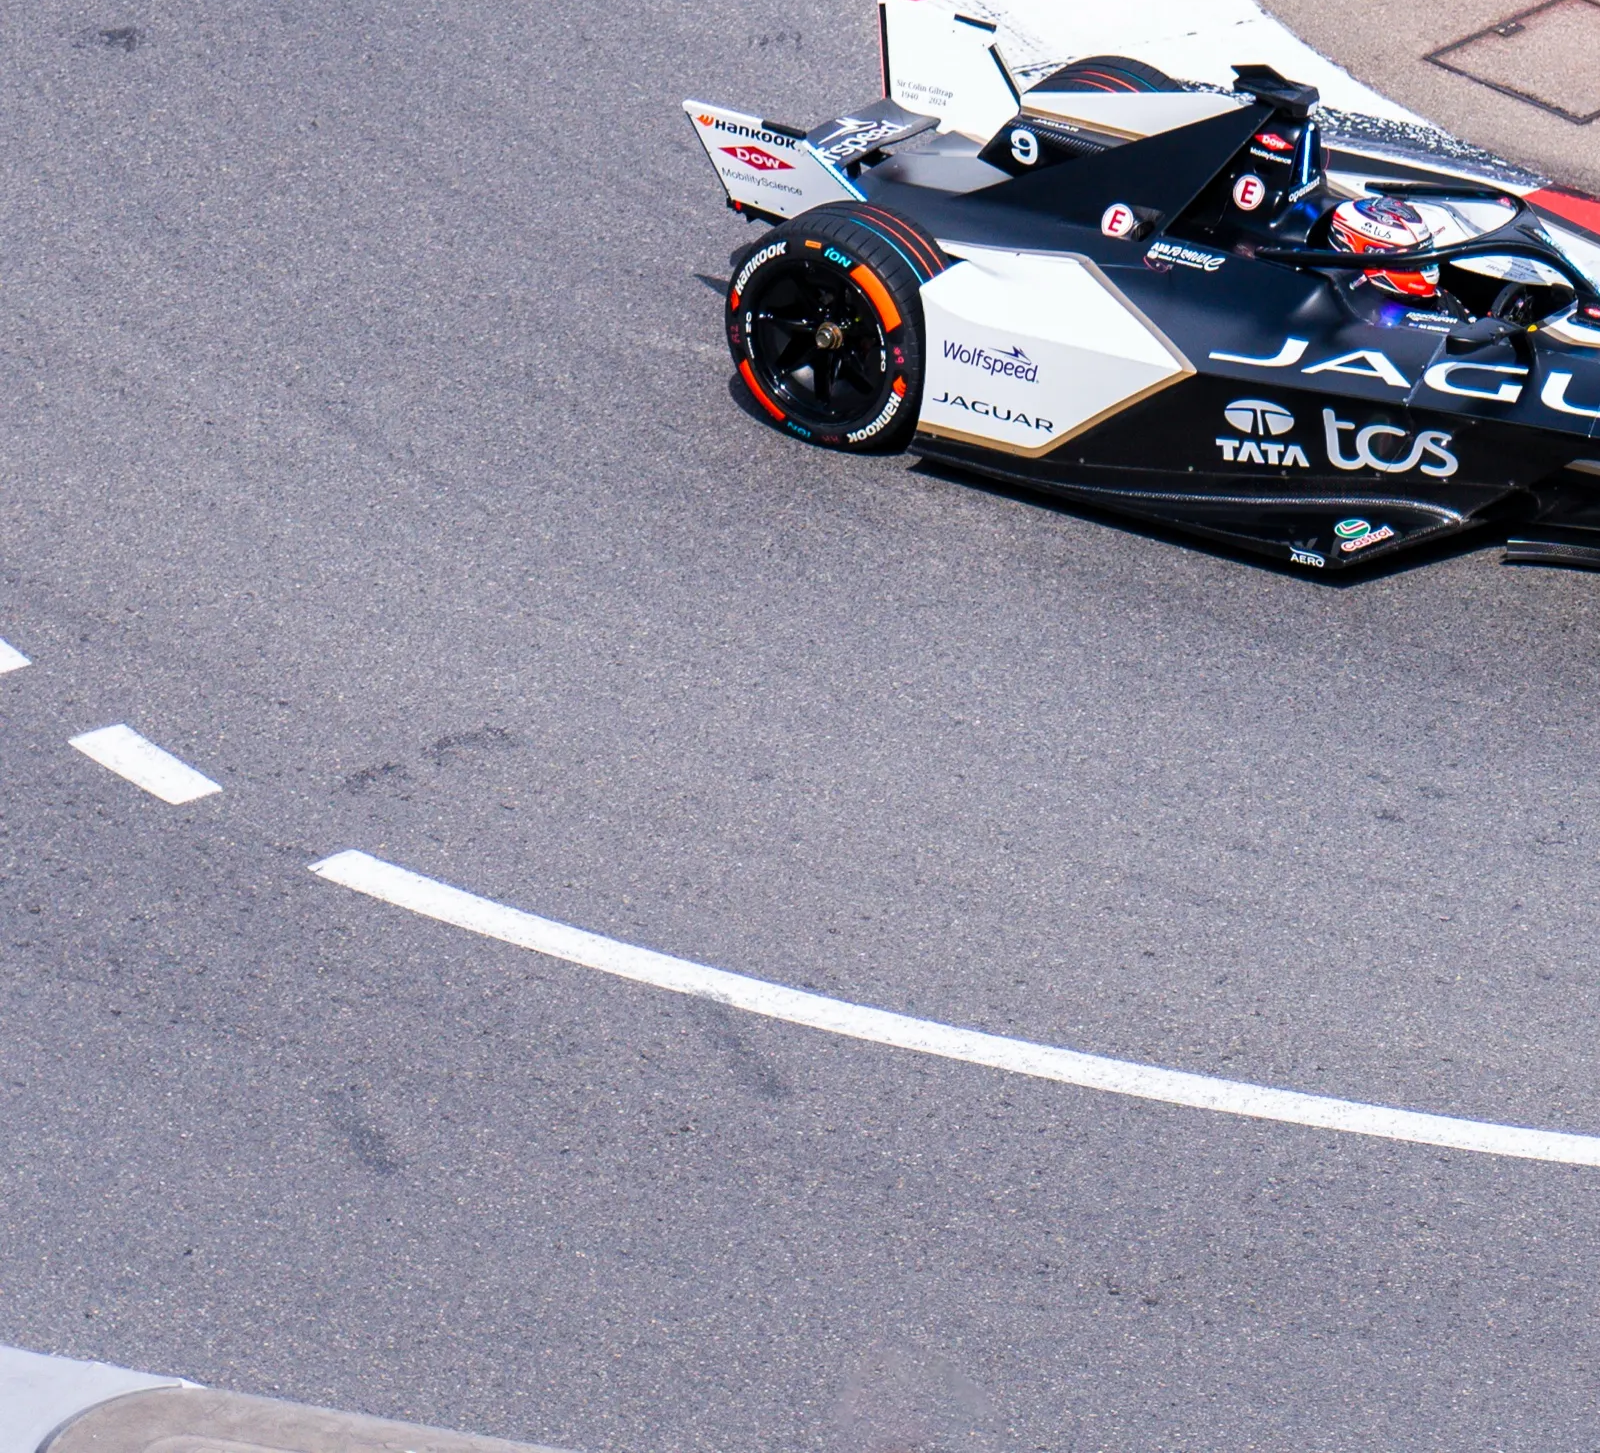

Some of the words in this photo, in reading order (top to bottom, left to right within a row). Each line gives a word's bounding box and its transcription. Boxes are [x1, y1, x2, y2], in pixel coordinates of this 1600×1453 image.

[1010, 129, 1039, 165] 9
[720, 166, 804, 196] MobilityScience
[1240, 180, 1258, 204] E
[1107, 209, 1127, 233] E
[943, 340, 1040, 384] Wolfspeed
[932, 392, 1054, 434] JAGUAR
[1215, 438, 1310, 468] TATA
[1322, 407, 1459, 477] tcs
[1341, 525, 1394, 552] Castrol
[1290, 553, 1324, 568] AERO
